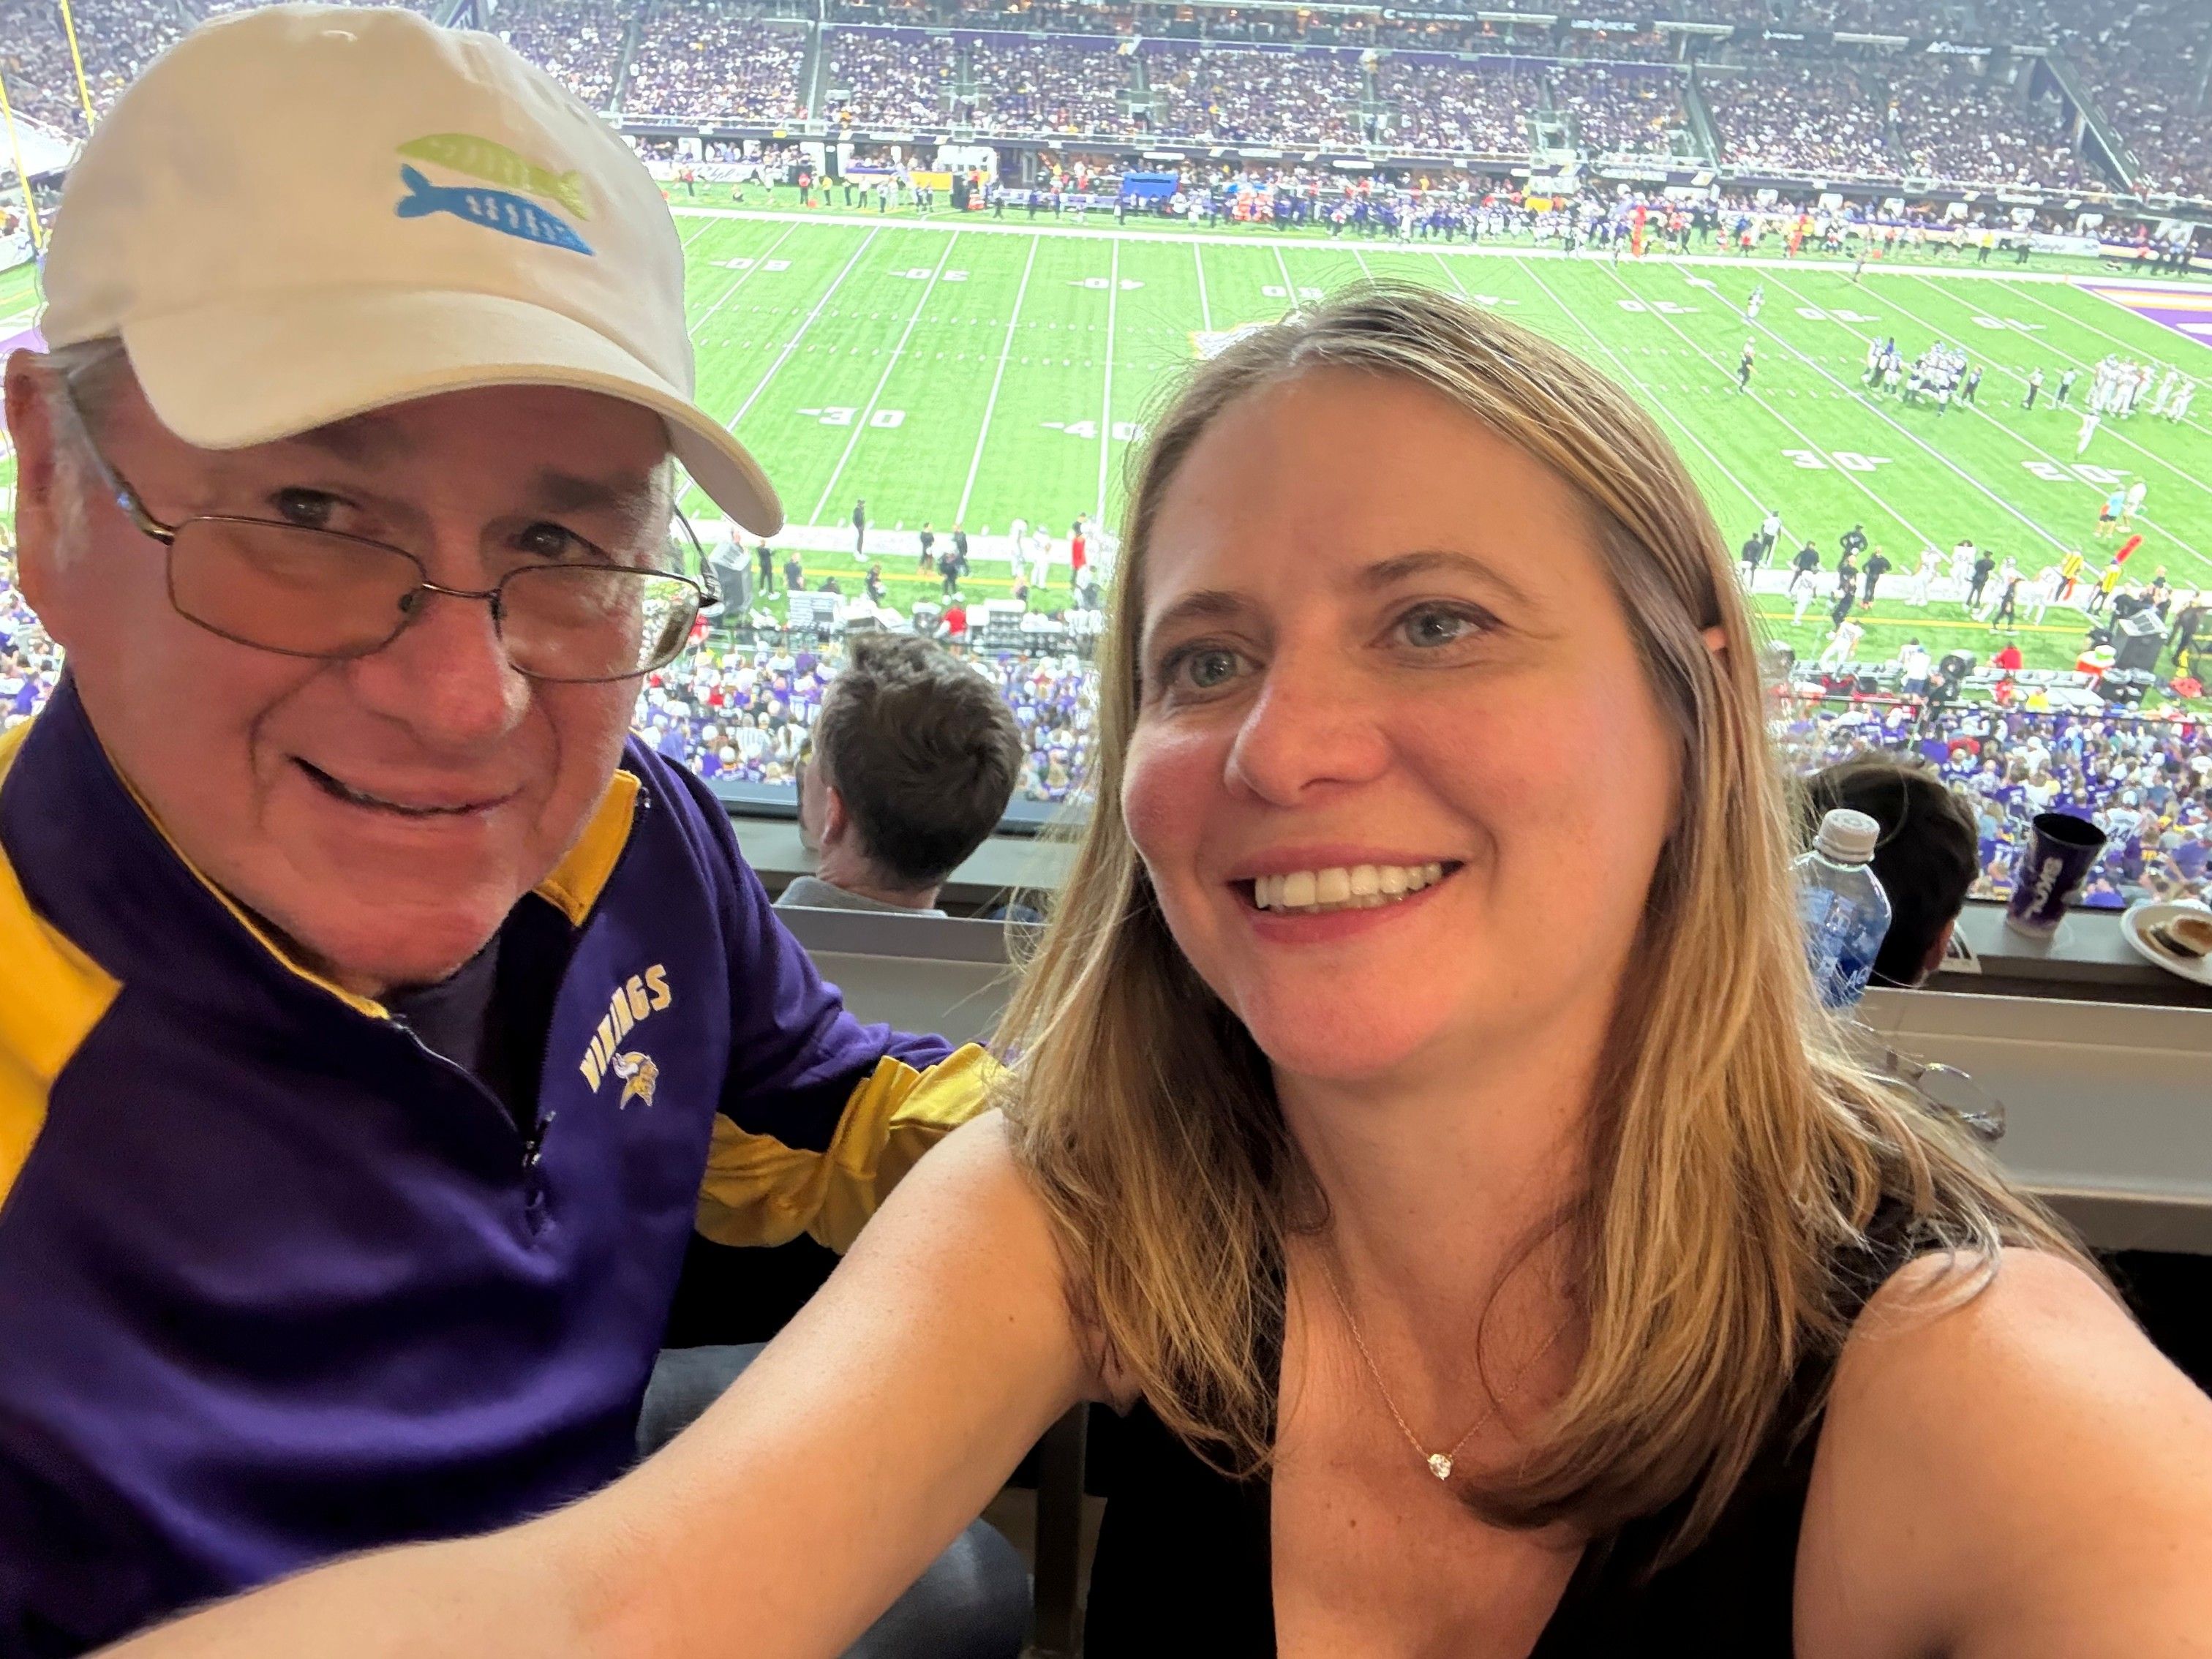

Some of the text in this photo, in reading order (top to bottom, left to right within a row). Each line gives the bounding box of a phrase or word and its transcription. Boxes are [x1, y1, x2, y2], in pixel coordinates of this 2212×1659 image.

[819, 406, 906, 428] 30
[1780, 449, 1876, 471] 30
[2021, 461, 2119, 484] 20
